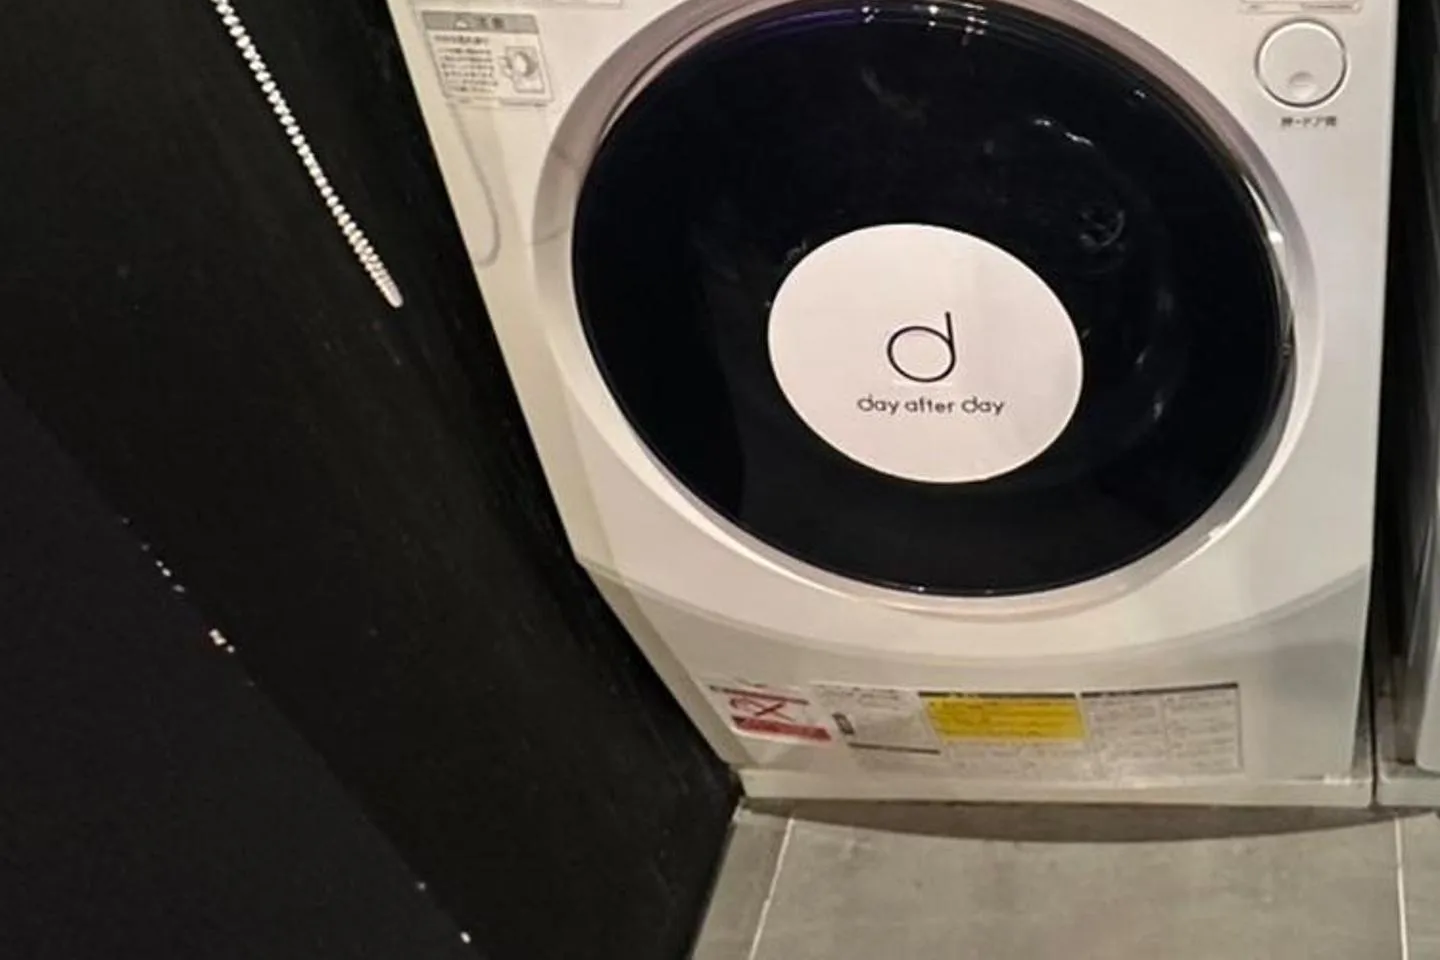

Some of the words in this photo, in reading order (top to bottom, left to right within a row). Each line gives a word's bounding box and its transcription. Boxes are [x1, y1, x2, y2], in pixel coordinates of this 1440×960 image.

[887, 311, 956, 383] d
[857, 394, 899, 416] day
[903, 396, 955, 415] after
[961, 396, 1006, 416] day
